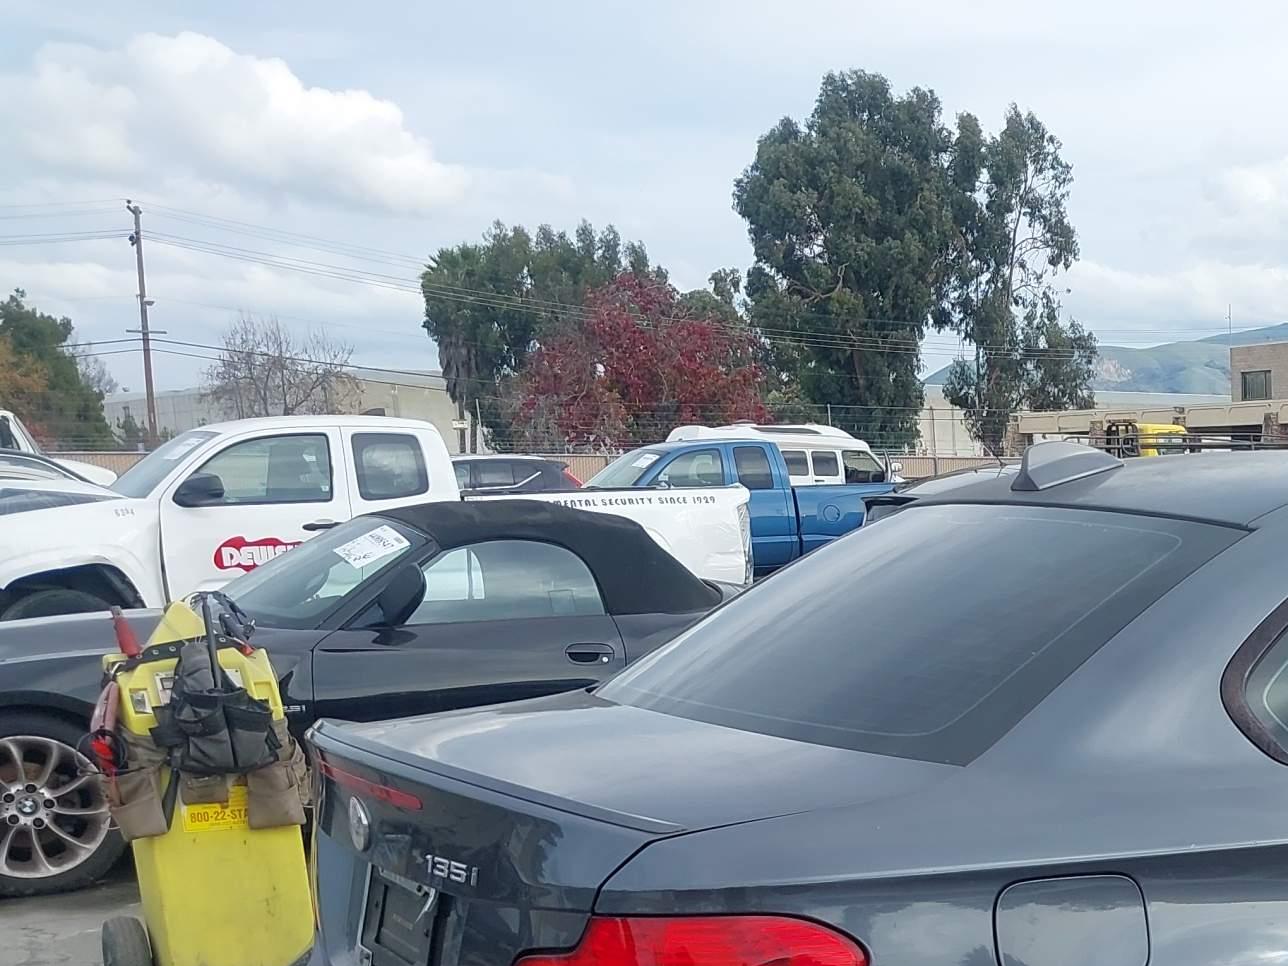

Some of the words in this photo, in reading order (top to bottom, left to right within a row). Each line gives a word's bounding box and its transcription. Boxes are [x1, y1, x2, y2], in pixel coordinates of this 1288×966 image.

[601, 497, 653, 506] SECURITY
[658, 496, 688, 505] SINCE
[692, 496, 716, 504] 1929
[425, 854, 479, 887] 135i
